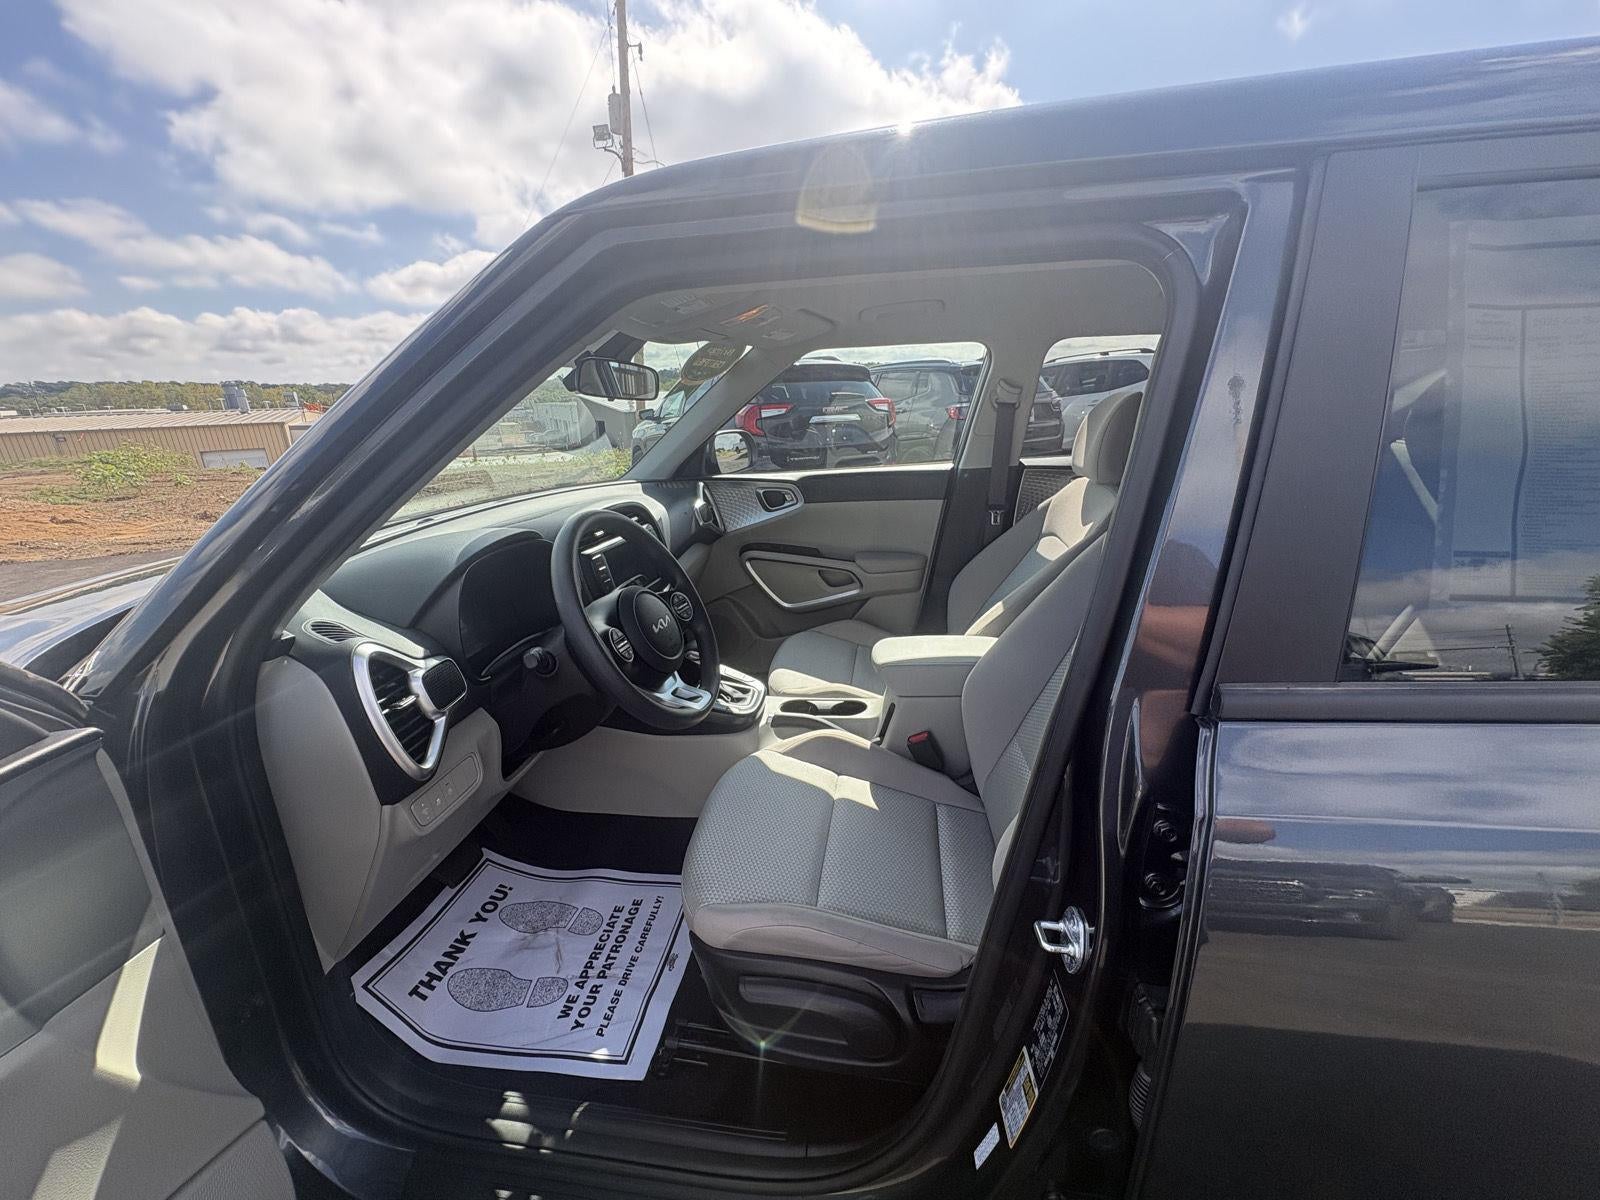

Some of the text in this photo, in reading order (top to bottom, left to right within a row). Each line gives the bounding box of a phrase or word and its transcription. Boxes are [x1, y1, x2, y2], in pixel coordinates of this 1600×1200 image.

[407, 883, 514, 1002] THANK YOU!
[556, 904, 625, 1020] WE APPRECIATE
[570, 898, 644, 1032] YOUR PATRONAGE
[595, 894, 665, 1038] PLEASE DRIVE CAREFULLY!
